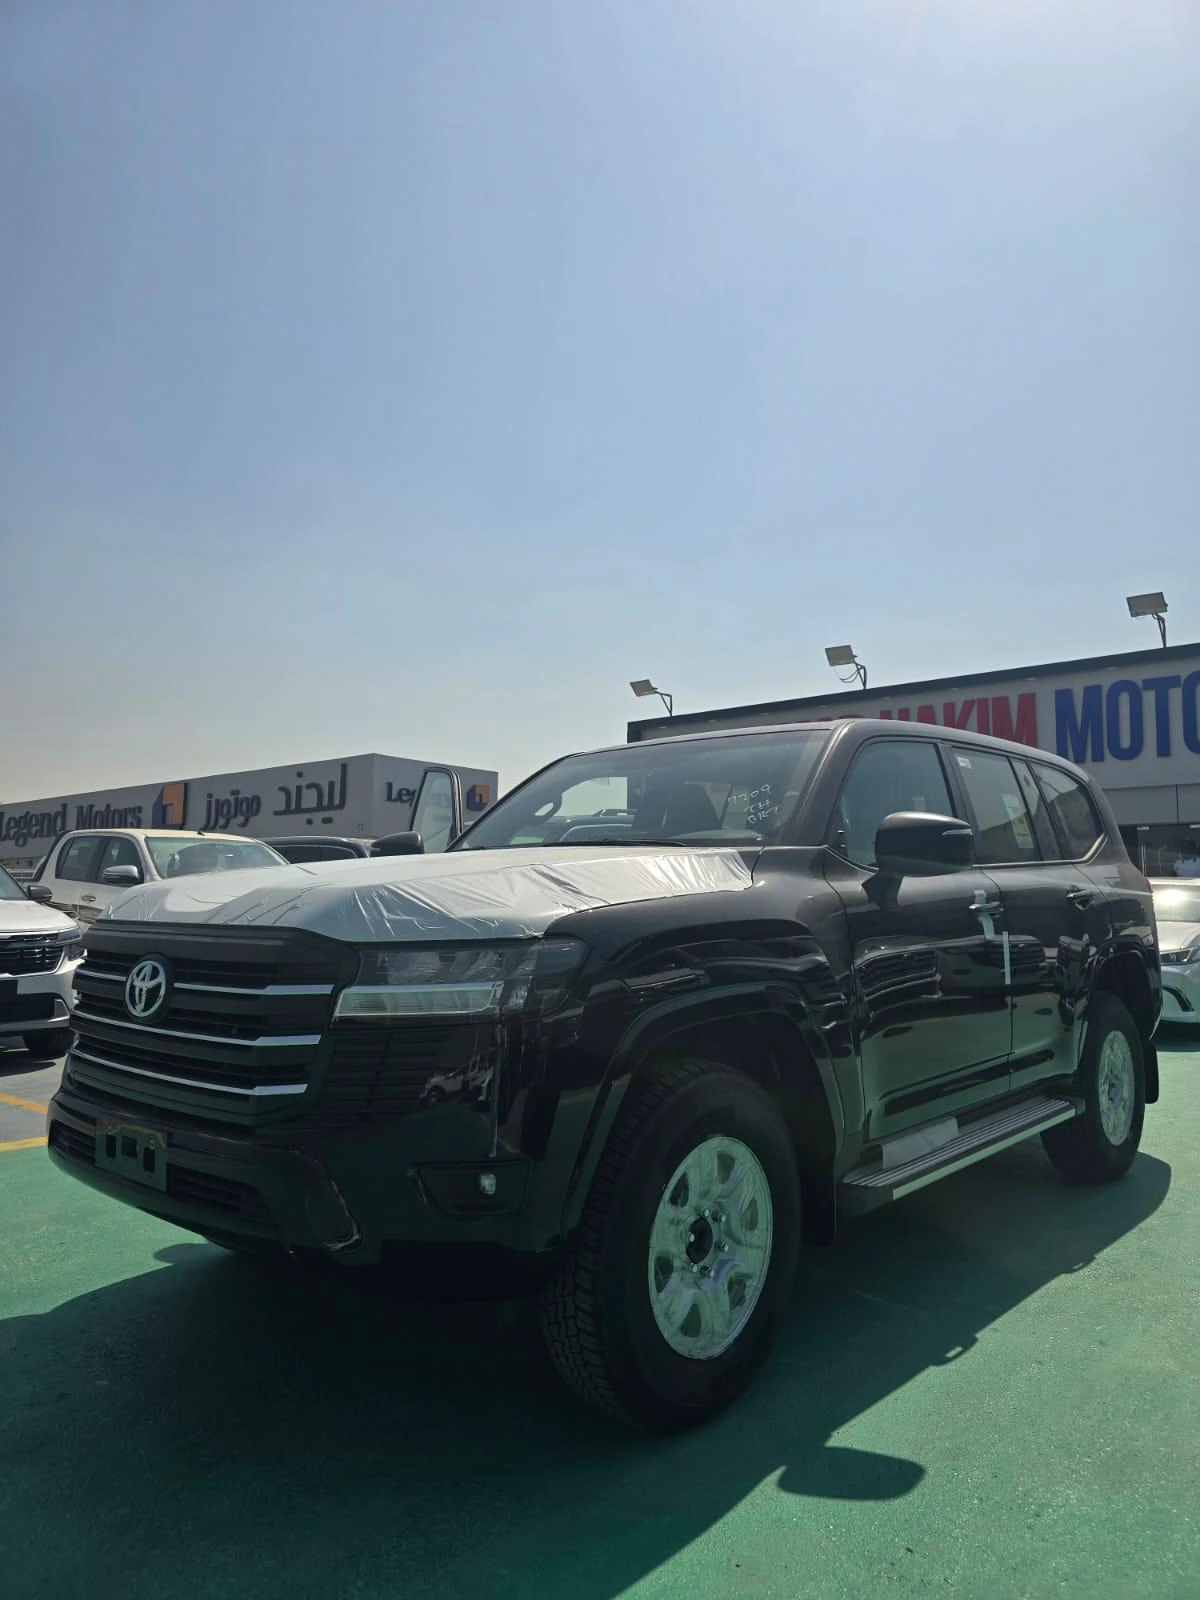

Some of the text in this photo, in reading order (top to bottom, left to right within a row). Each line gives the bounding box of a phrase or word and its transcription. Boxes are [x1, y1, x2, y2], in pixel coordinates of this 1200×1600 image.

[0, 803, 143, 848] Legend Motors
[199, 763, 347, 832] ليجند موتورز
